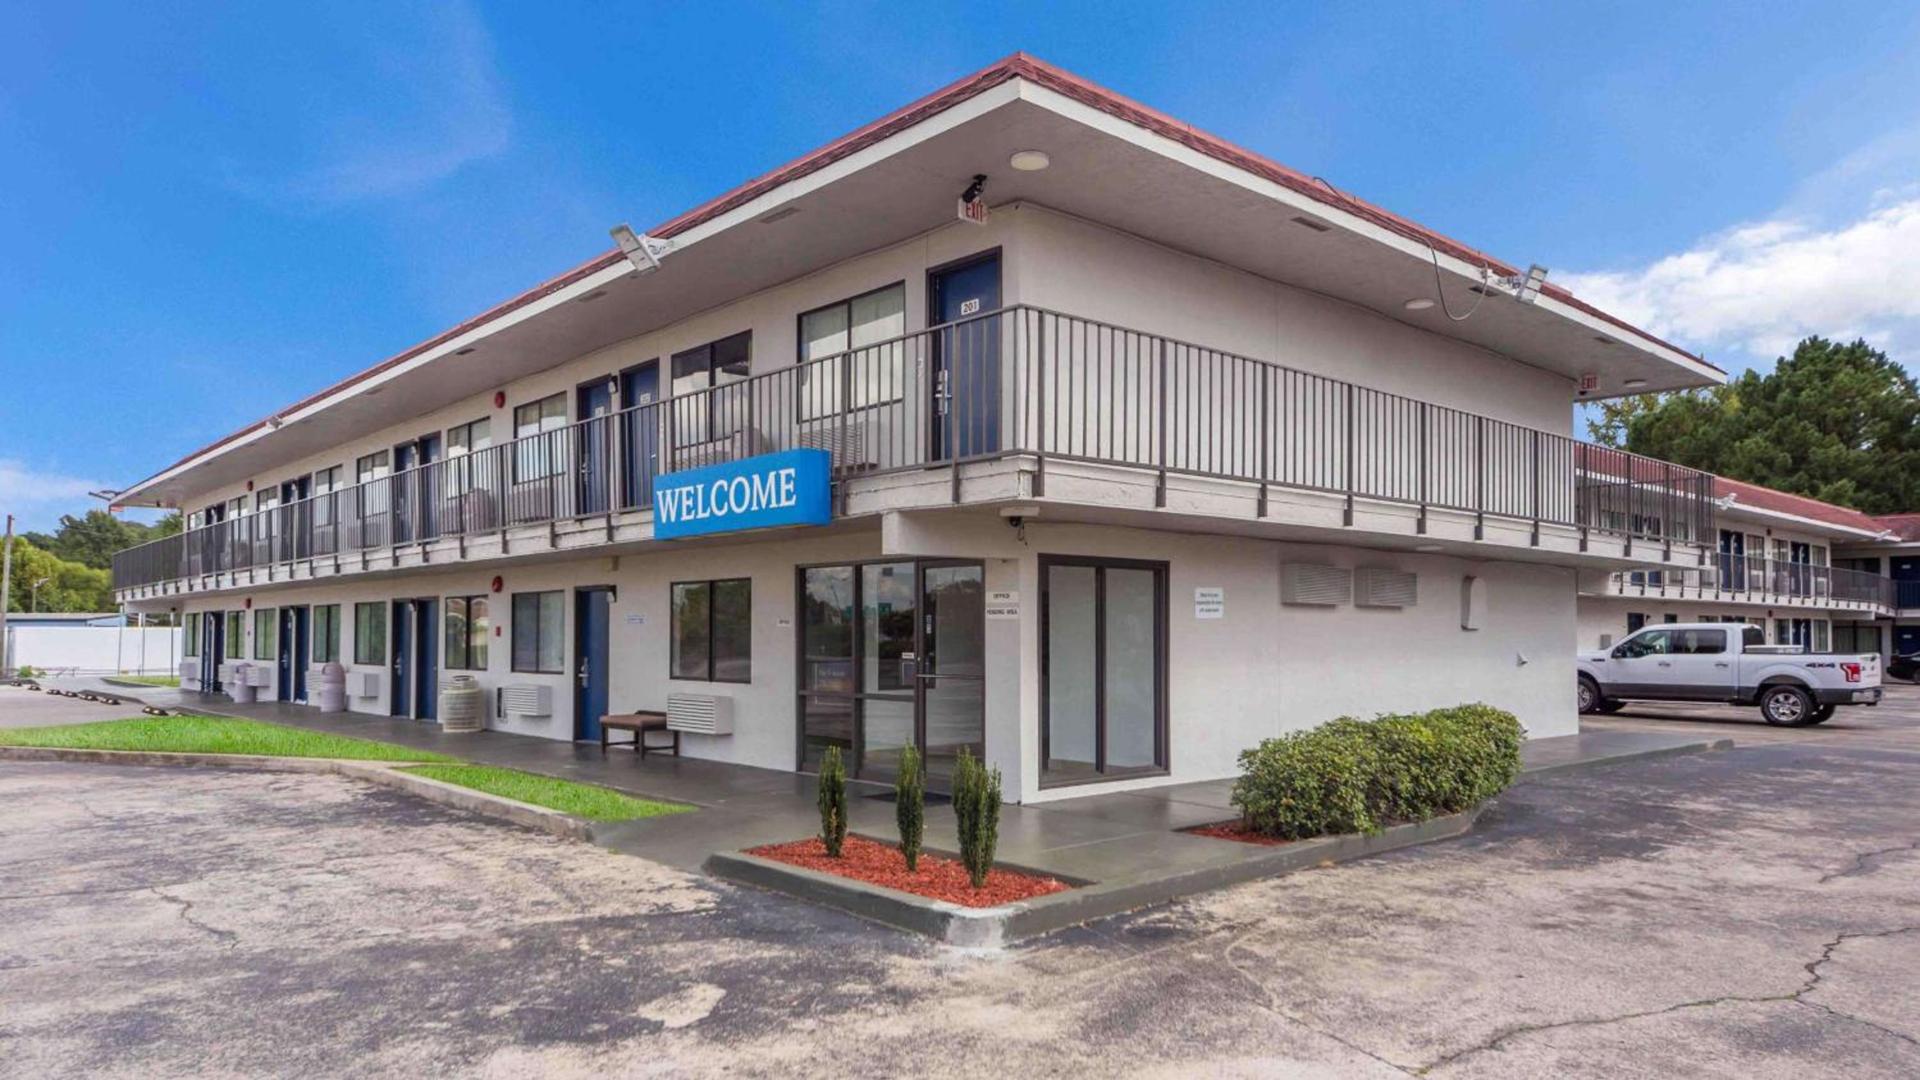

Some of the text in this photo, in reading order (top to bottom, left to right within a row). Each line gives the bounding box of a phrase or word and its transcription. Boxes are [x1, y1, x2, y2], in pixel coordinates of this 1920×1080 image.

[965, 201, 983, 222] EXIT
[963, 301, 977, 313] 201
[656, 467, 797, 524] WELCOME
